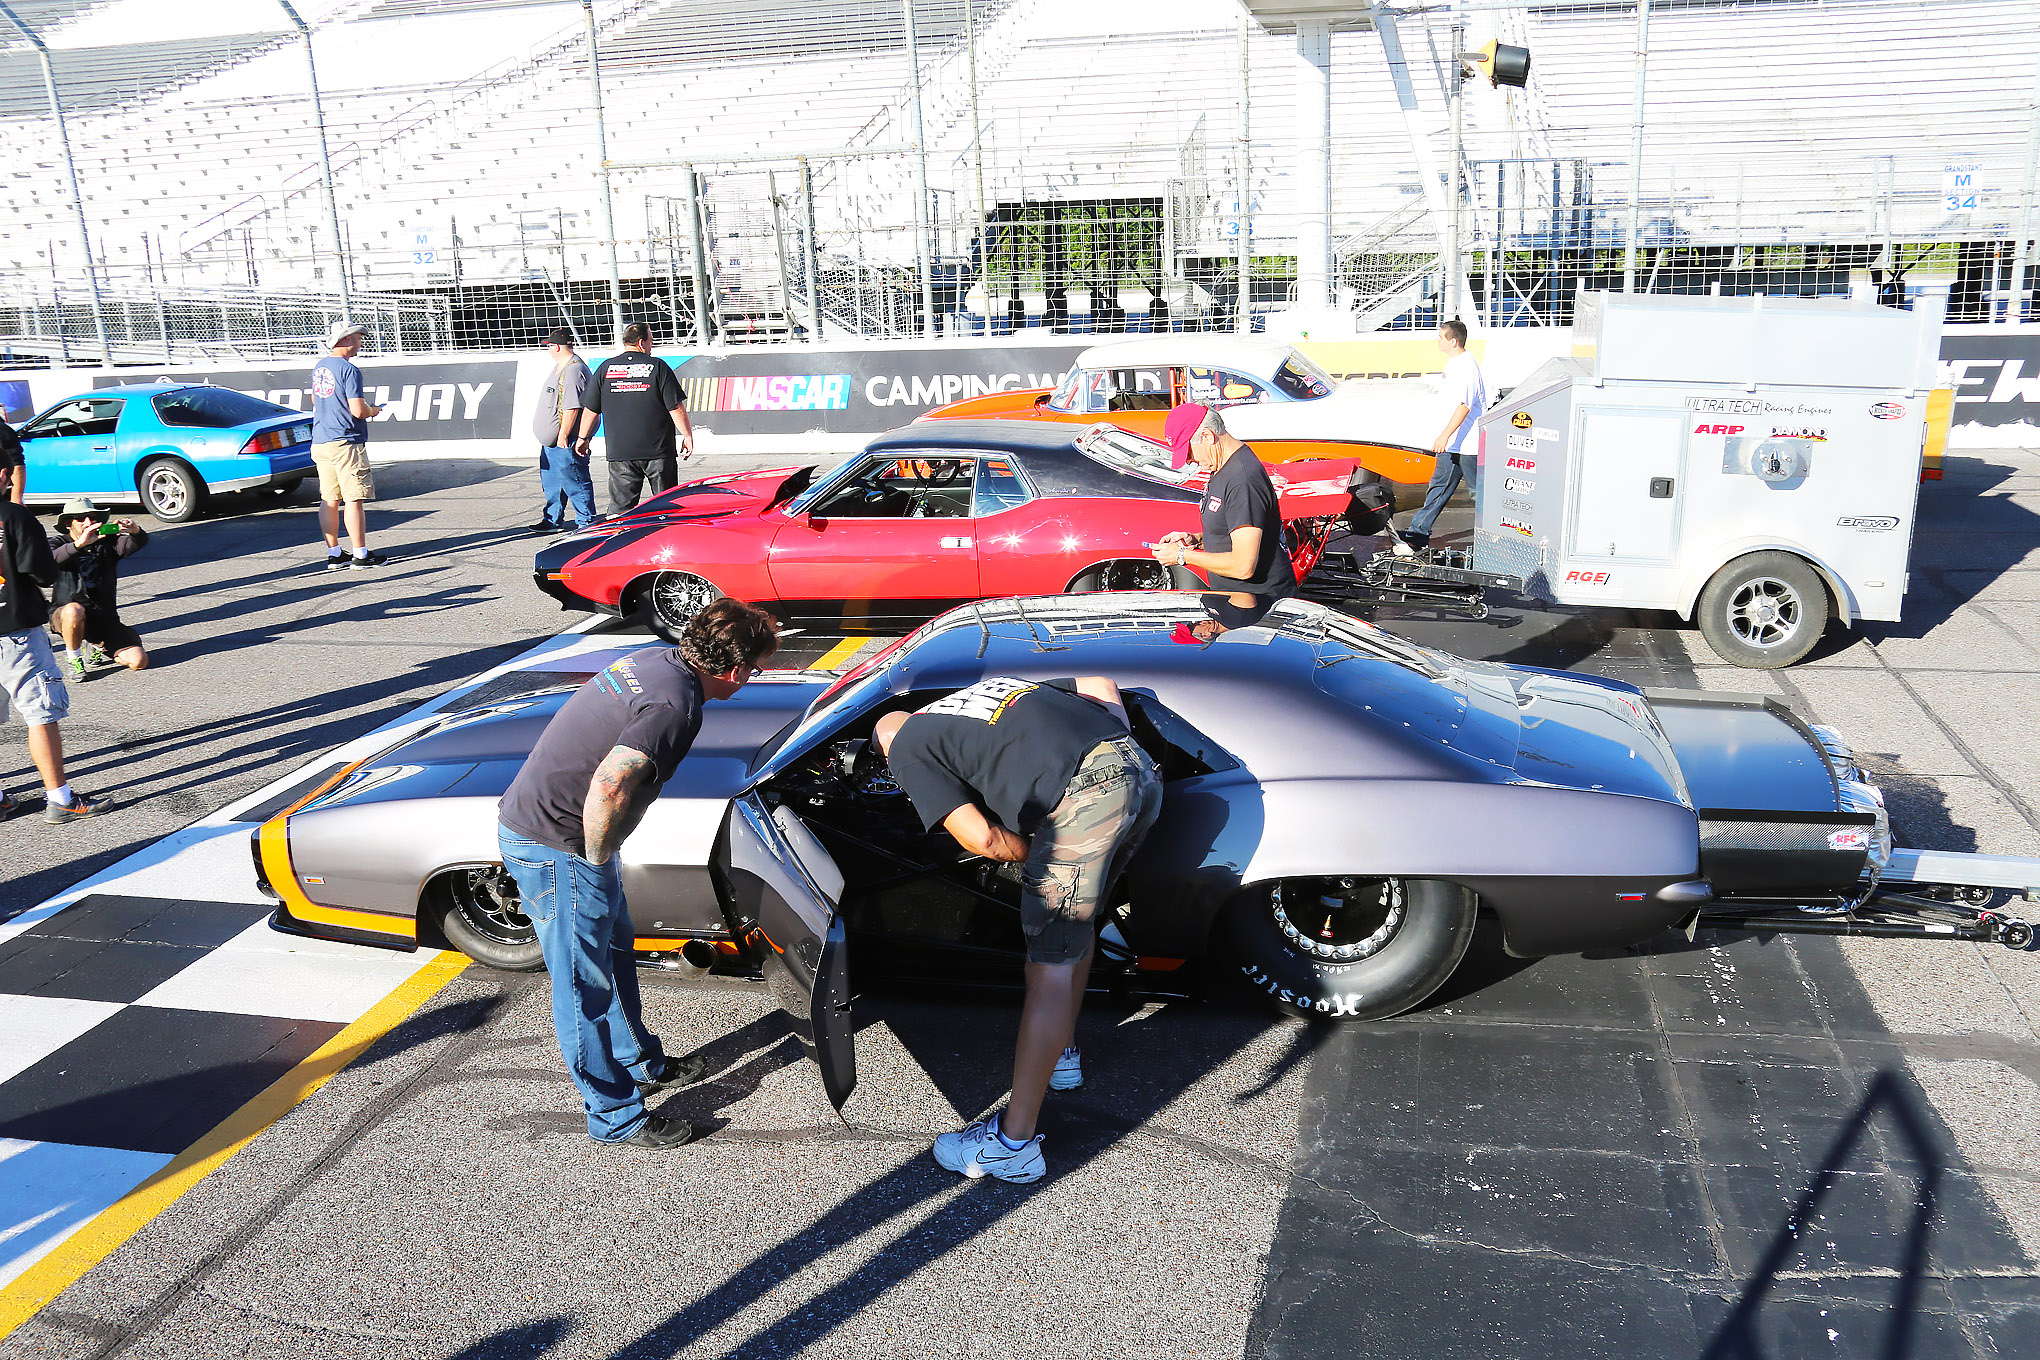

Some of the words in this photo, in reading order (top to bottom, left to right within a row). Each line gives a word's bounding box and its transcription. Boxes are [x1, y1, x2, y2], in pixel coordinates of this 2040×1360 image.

[1944, 163, 1983, 172] GRANDSTAND
[1954, 174, 1971, 186] M
[1944, 188, 1980, 196] SECTION
[1946, 196, 1977, 210] 34
[416, 234, 428, 244] M
[412, 252, 434, 264] 32
[1937, 359, 2040, 403] EW
[731, 375, 846, 410] NASCAR
[865, 373, 1024, 407] CAMPING
[1686, 399, 1725, 412] ULTRA
[1728, 400, 1761, 413] TECH
[1764, 402, 1794, 415] Racing
[1797, 403, 1832, 417] Engines
[1694, 424, 1744, 435] ARP
[1771, 426, 1829, 437] DIAMOND
[1508, 435, 1535, 449] OLIVER
[1506, 457, 1536, 470] ARP
[1500, 516, 1534, 532] DIAMOND
